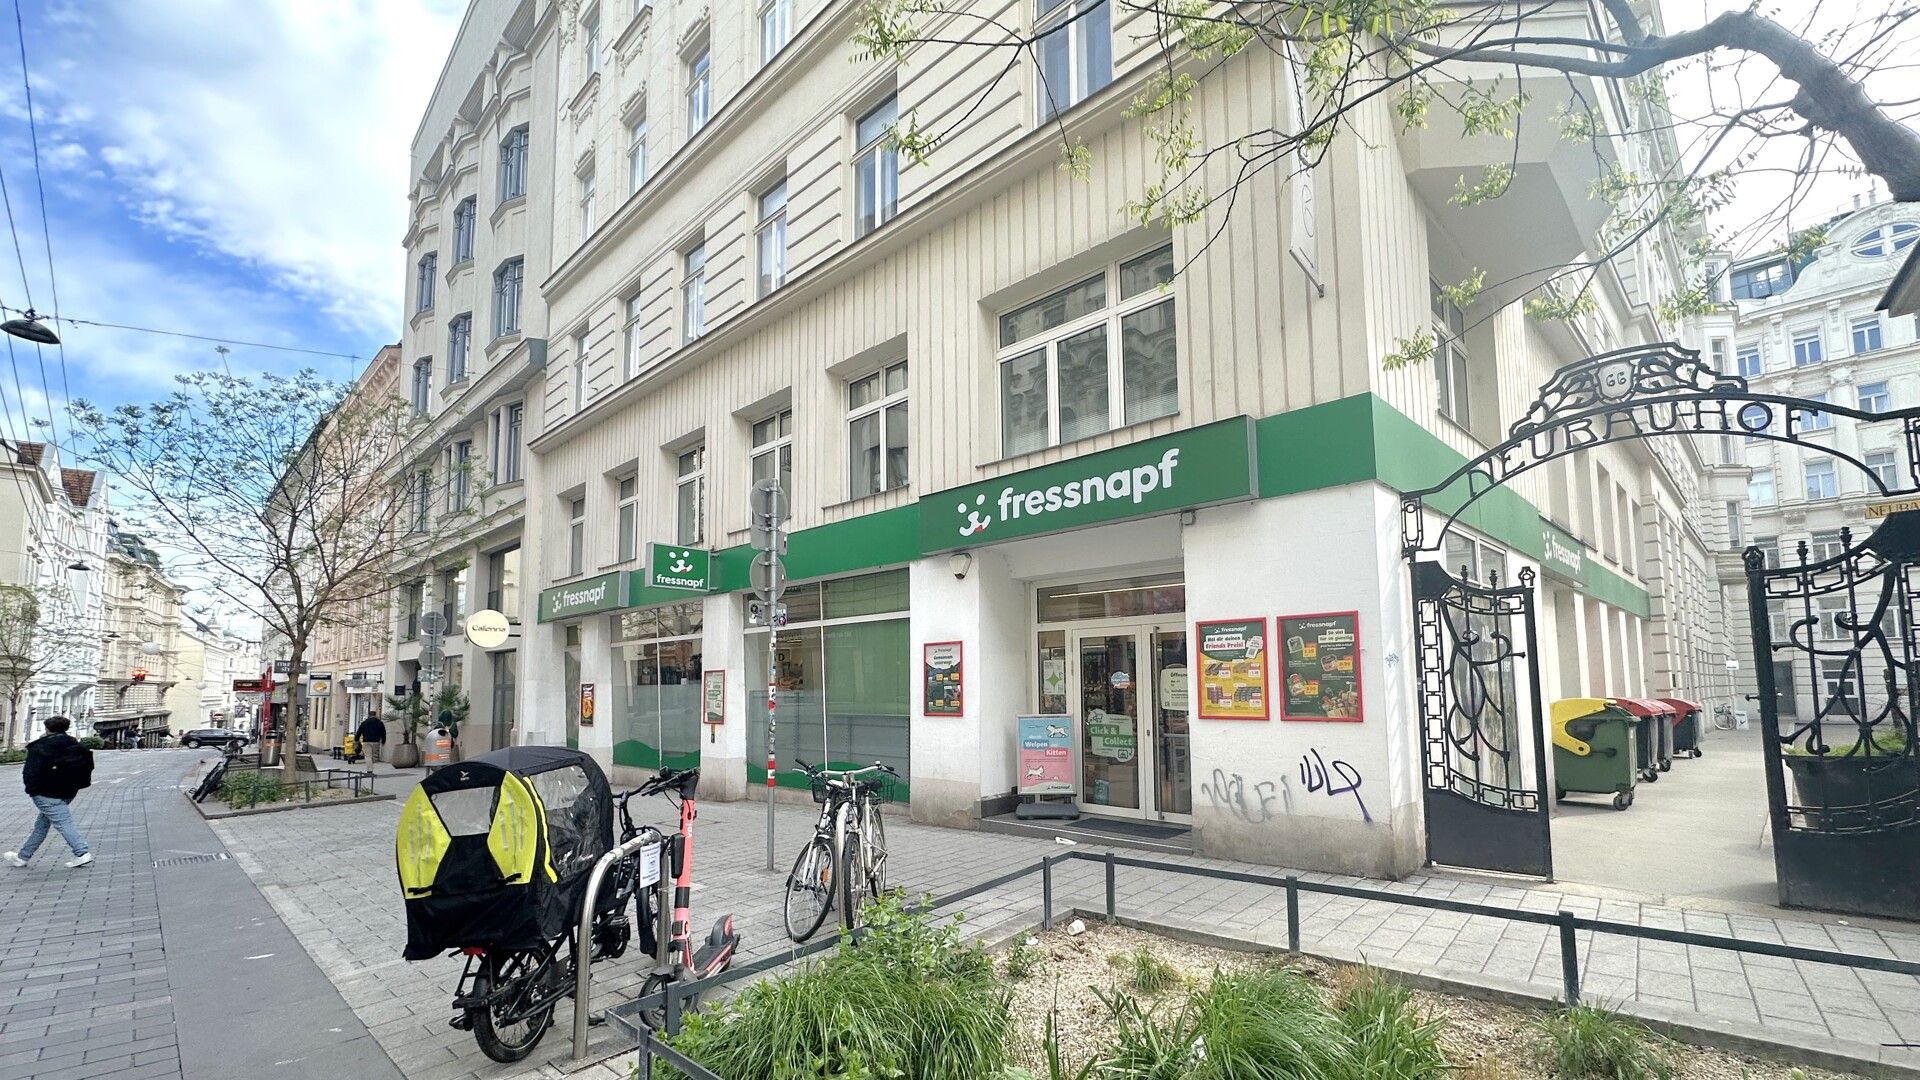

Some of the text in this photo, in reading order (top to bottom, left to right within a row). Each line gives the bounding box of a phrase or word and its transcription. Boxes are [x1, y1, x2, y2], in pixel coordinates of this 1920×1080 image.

[998, 448, 1180, 521] fressnapf
[656, 573, 704, 589] fressnapf
[563, 581, 606, 607] fressnapf
[1221, 625, 1248, 633] fressnapf
[1306, 620, 1337, 629] fressnapf
[1105, 737, 1132, 745] Collect
